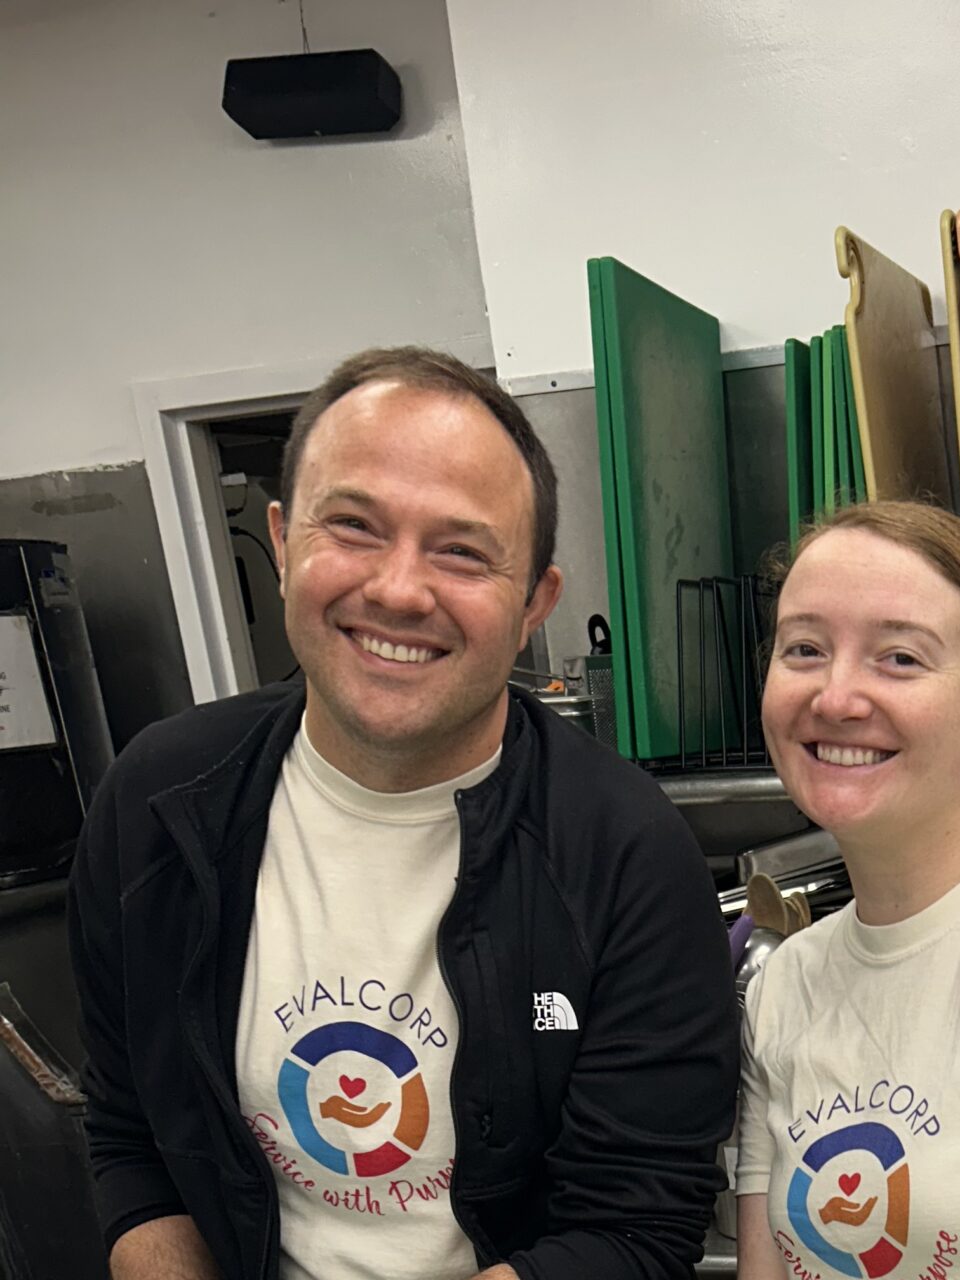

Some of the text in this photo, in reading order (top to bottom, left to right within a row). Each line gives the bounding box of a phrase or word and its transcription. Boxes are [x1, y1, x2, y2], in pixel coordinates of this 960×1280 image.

[274, 976, 448, 1050] EVALCORP
[788, 1080, 940, 1143] EVALCORP
[323, 1184, 386, 1216] with
